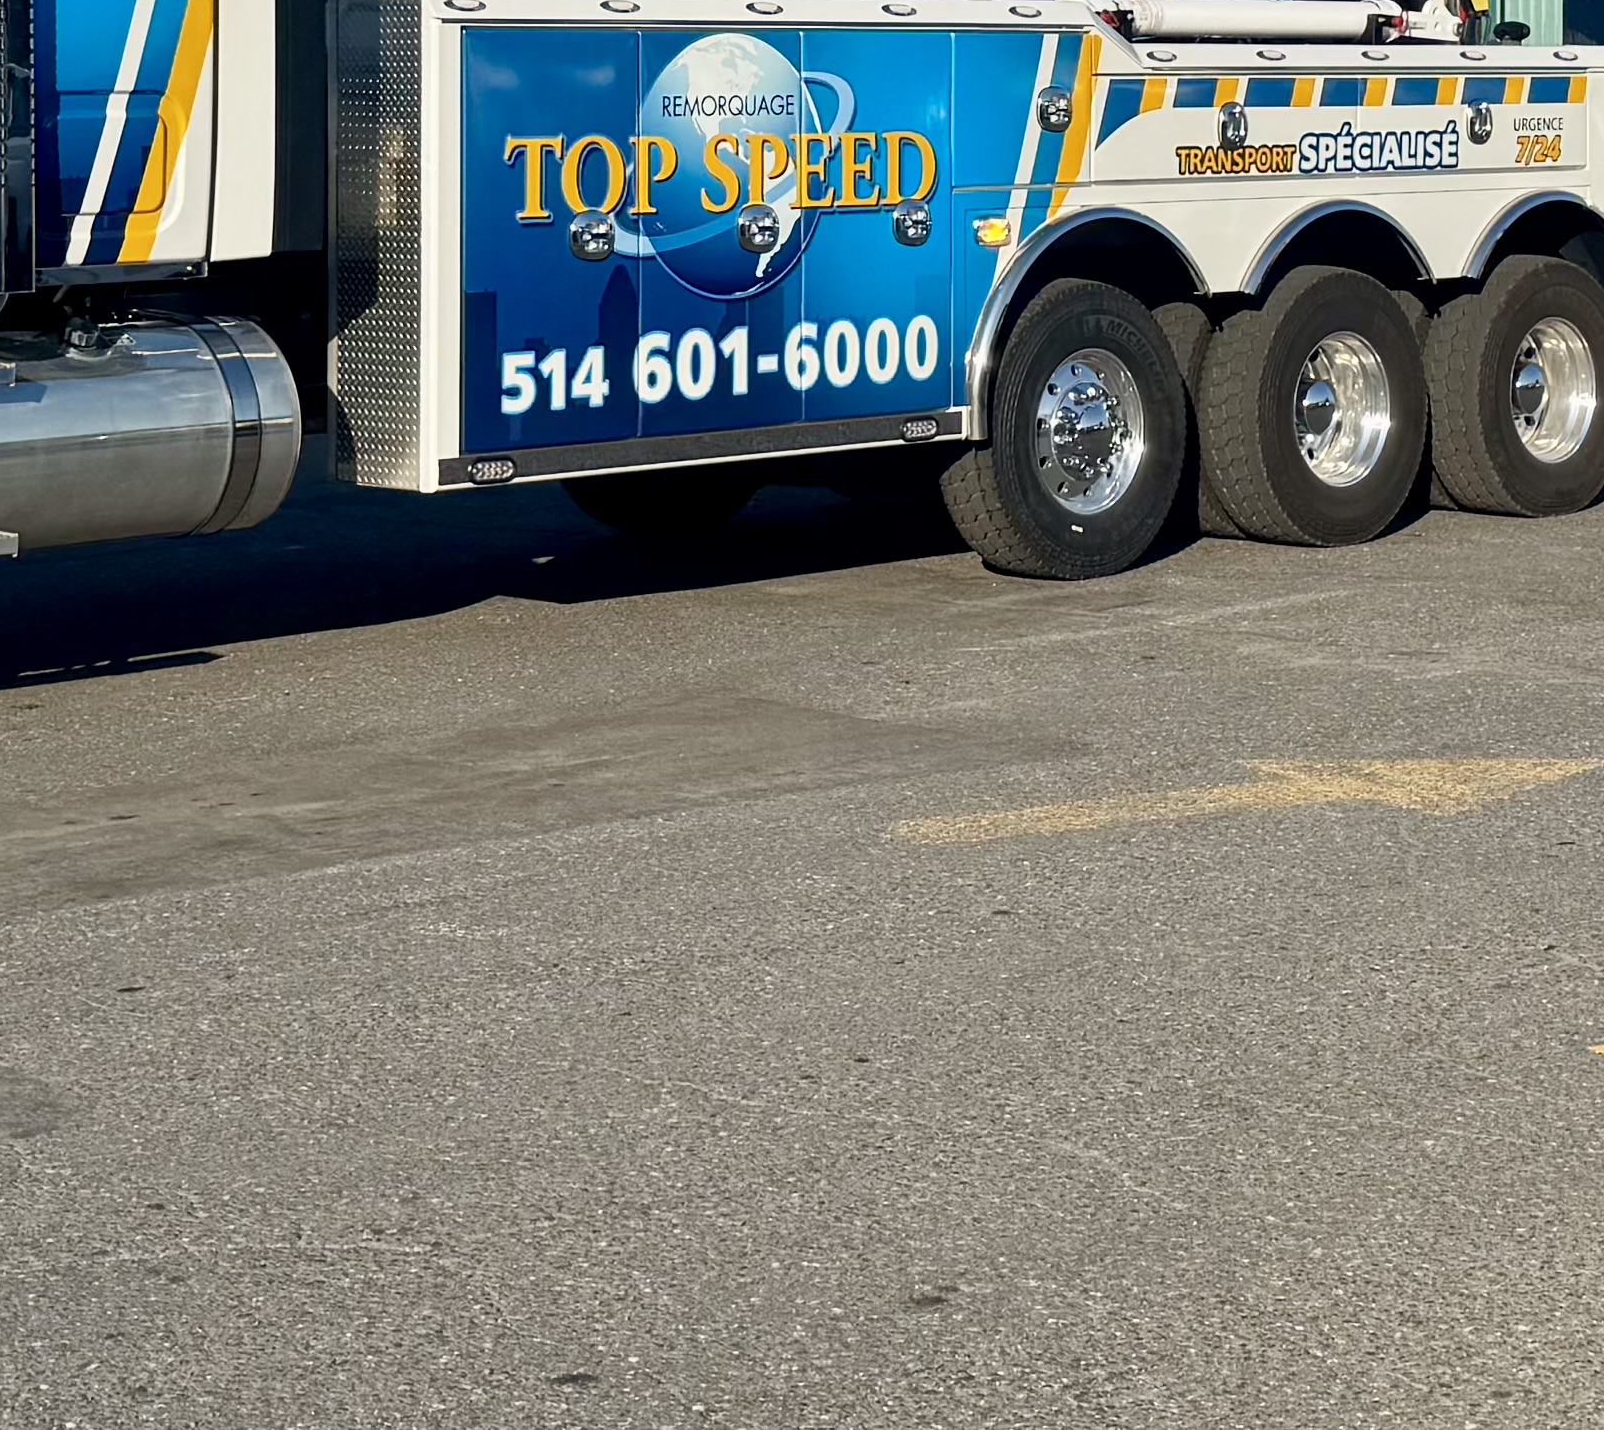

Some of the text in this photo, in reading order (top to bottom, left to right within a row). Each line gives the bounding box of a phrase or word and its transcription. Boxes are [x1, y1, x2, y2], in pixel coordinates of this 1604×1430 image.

[661, 94, 795, 118] REMORQUAGE
[1513, 117, 1564, 132] URGENCE
[1176, 120, 1460, 176] TRANSPORT SPÉCIALISÉ
[1514, 134, 1562, 167] 7/24
[504, 131, 939, 220] TOP SPEED
[500, 315, 939, 415] 514 601-6000
